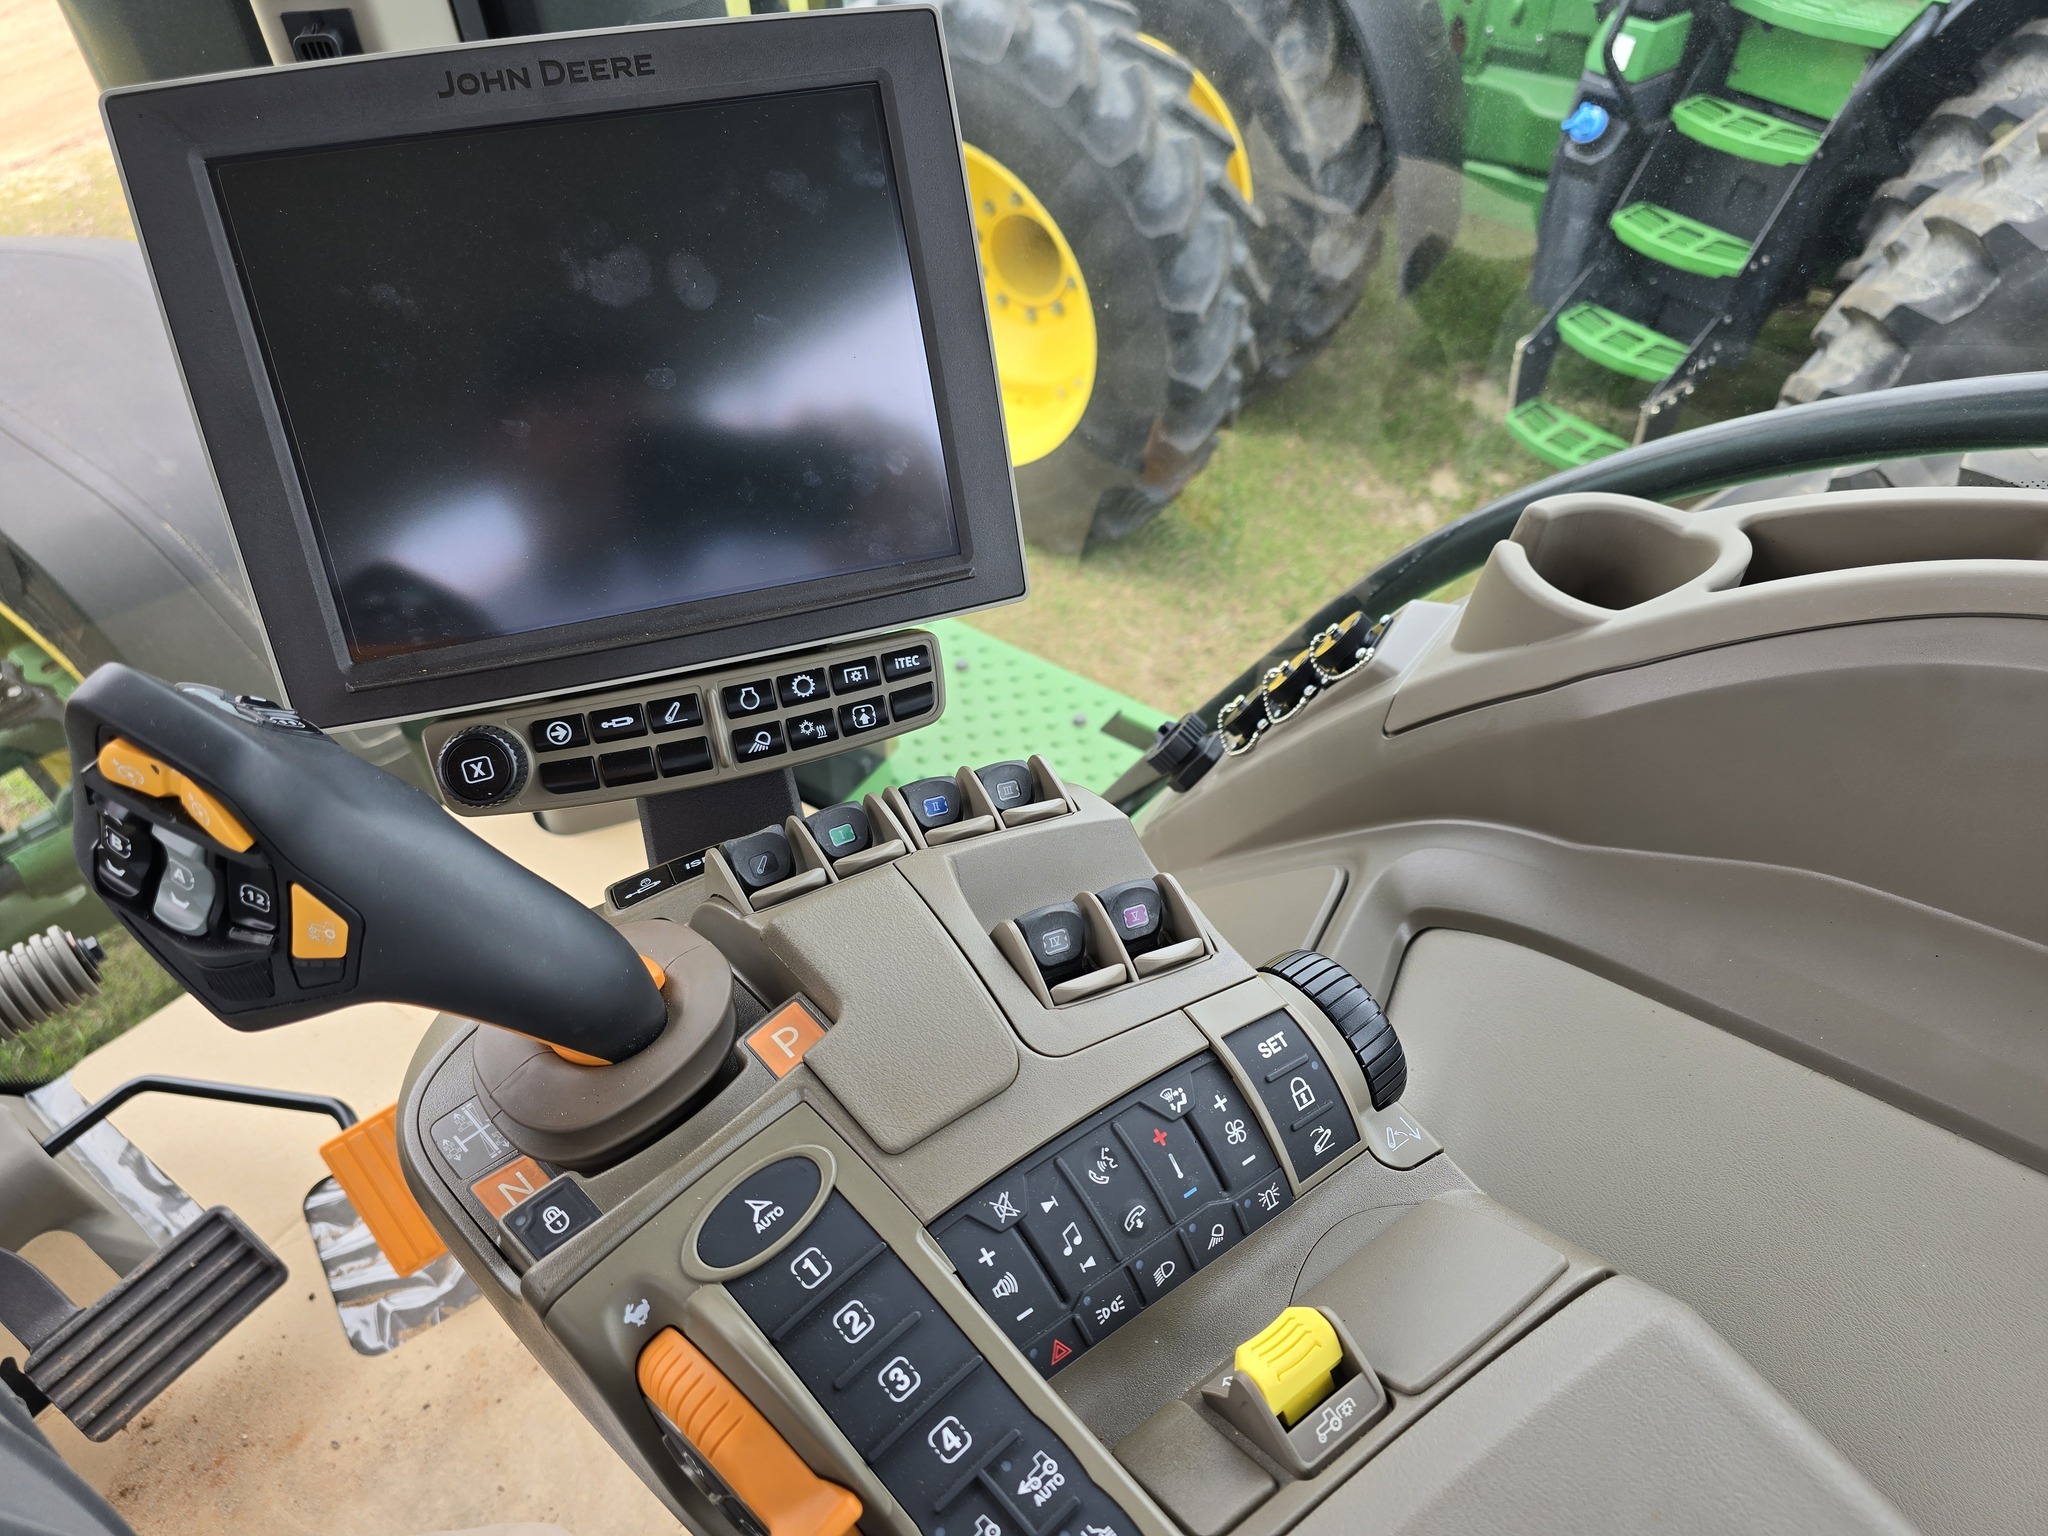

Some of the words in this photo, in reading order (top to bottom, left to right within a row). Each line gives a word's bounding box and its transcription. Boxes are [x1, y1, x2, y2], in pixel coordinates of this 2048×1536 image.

[437, 67, 532, 99] JOHN
[538, 54, 656, 87] DEERE
[894, 654, 921, 670] iTEC
[469, 761, 487, 778] X
[932, 801, 941, 812] II
[110, 832, 123, 851] B
[247, 890, 266, 907] 12
[1048, 935, 1061, 948] IV
[770, 1026, 800, 1059] P
[1257, 1030, 1288, 1059] SET
[497, 1170, 533, 1206] N
[753, 1205, 786, 1235] AUTO
[801, 1256, 822, 1280] 1
[843, 1309, 868, 1336] 2
[887, 1366, 911, 1392] 3
[940, 1426, 963, 1453] 4
[1032, 1472, 1066, 1508] AUTO
